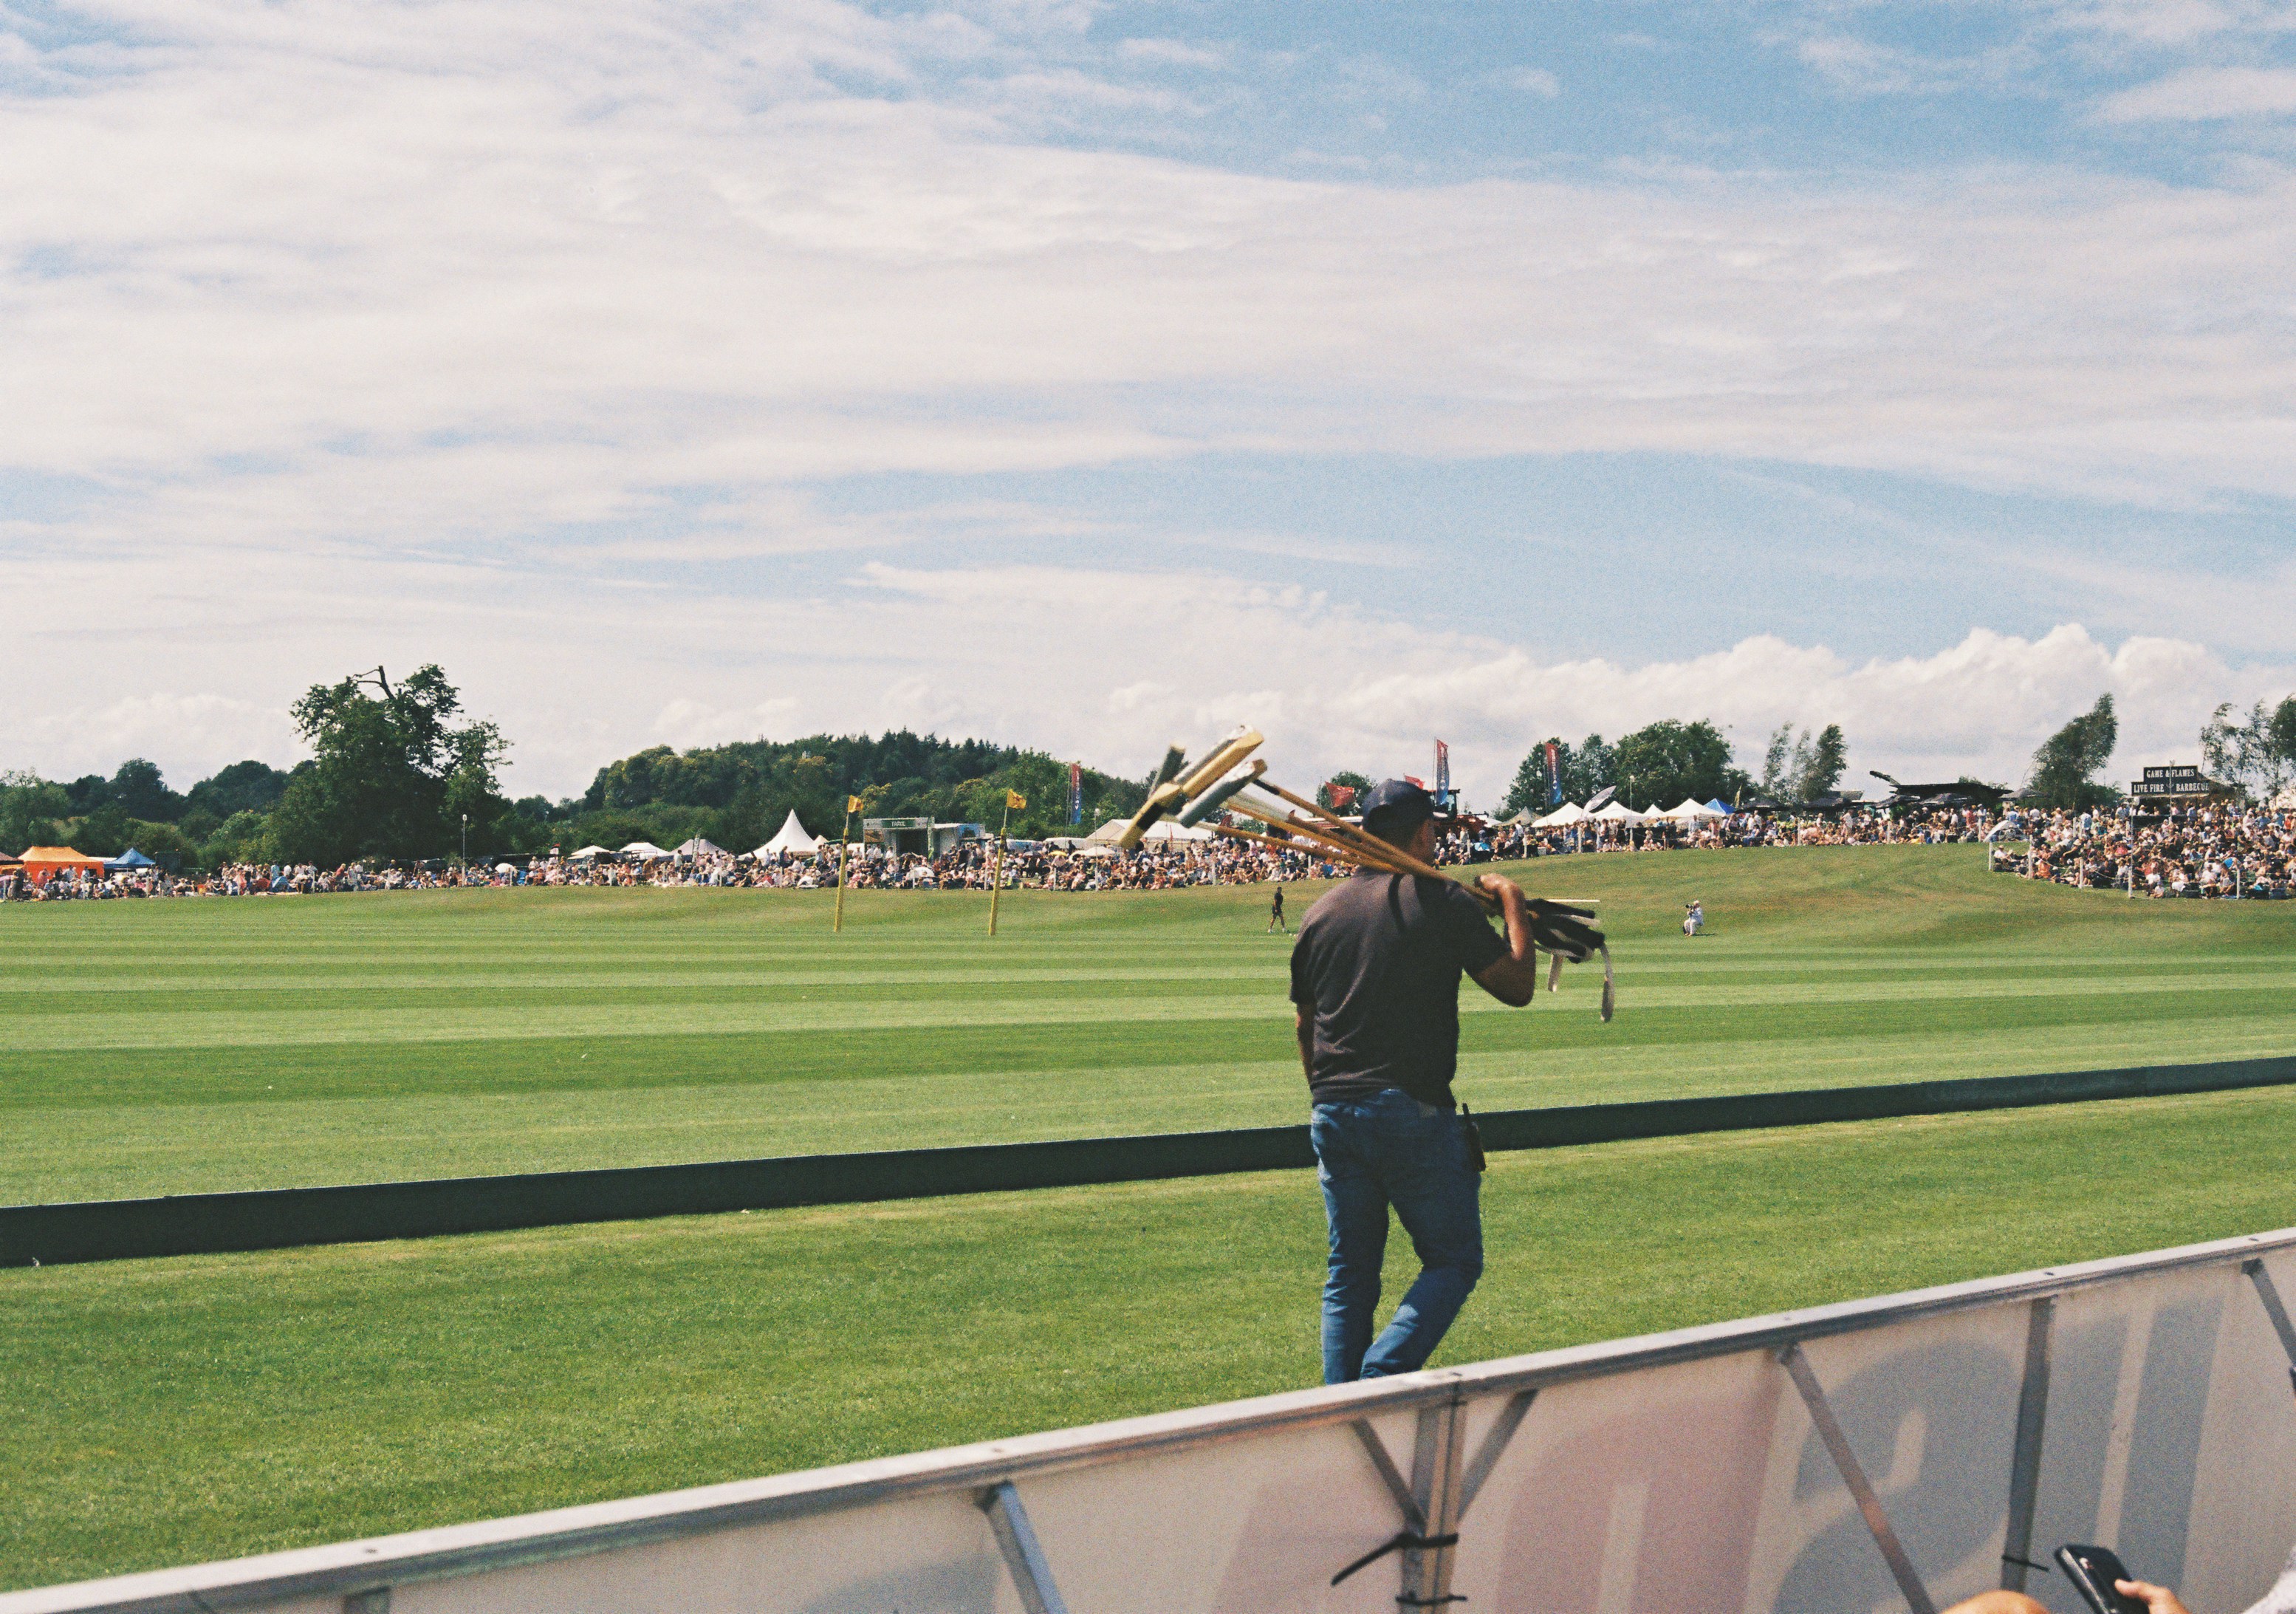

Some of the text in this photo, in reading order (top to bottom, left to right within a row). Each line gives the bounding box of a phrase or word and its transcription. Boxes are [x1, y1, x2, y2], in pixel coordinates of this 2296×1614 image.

[2146, 768, 2195, 778] GAME & FLAMES
[2134, 783, 2209, 793] LIVE FIRE BARBECUE
